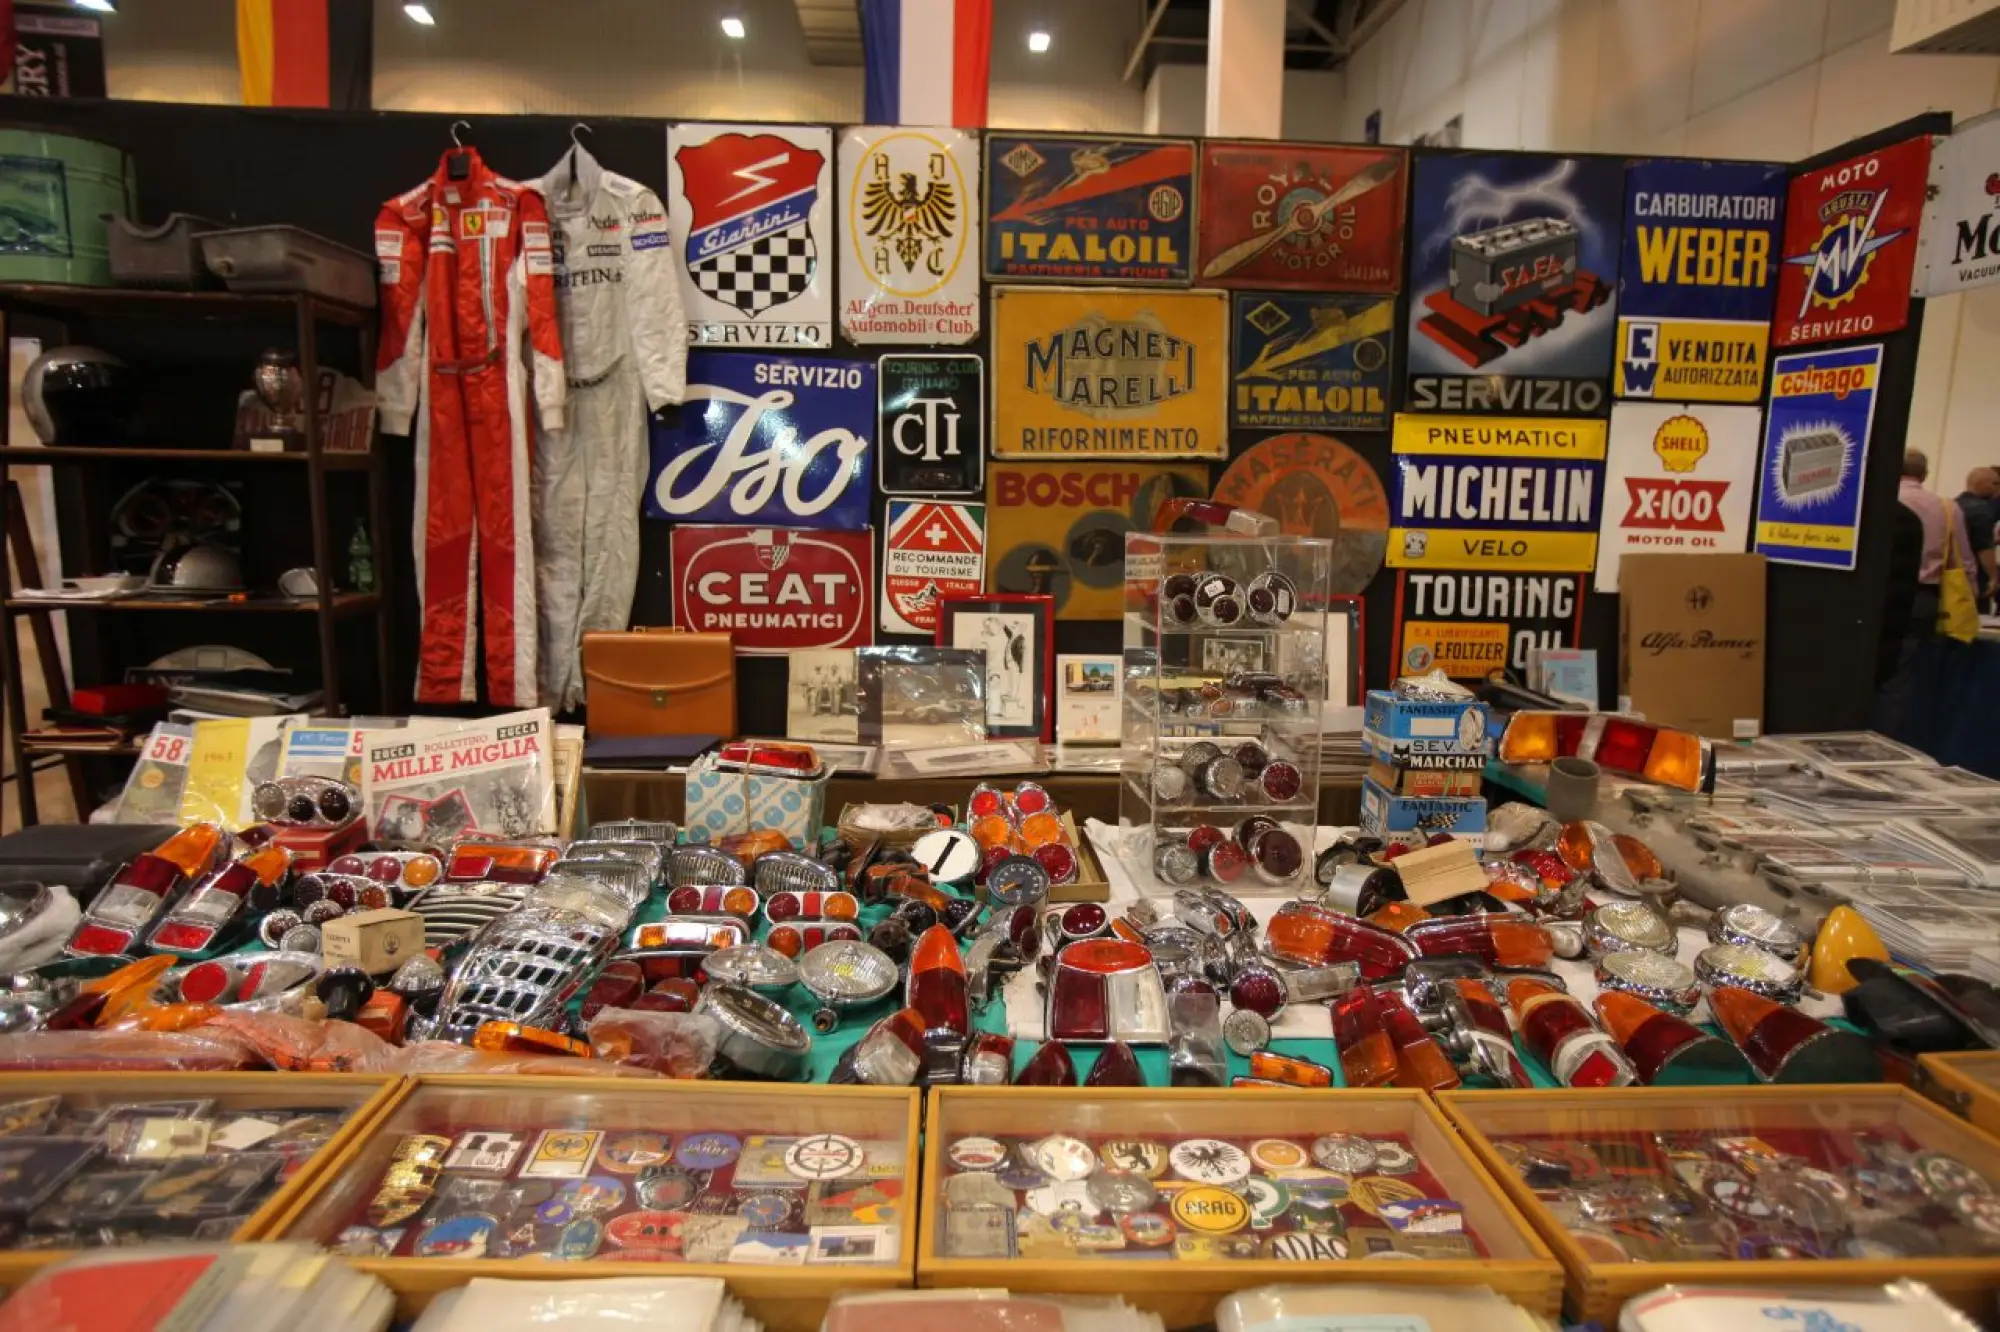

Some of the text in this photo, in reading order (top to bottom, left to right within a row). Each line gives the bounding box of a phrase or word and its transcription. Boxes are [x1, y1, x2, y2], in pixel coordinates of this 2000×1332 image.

[1820, 158, 1879, 192] MOTO
[1635, 192, 1776, 221] CARBURATORI
[698, 203, 801, 255] Giannini
[1272, 205, 1356, 269] MOTOR OIL
[1001, 232, 1178, 265] ITALOIL
[1636, 225, 1771, 289] WEBER
[689, 324, 820, 343] SERVIZIO
[1790, 315, 1874, 341] SERVIZIO
[1669, 339, 1757, 364] VENDITA
[755, 363, 862, 389] SERVIZIO
[1663, 366, 1759, 387] AUTORIZZATA
[1780, 366, 1865, 400] colnago
[1236, 385, 1385, 413] ITALOIL
[1414, 378, 1602, 412] SERVIZIO
[1022, 428, 1199, 450] RIFORNIMENTO
[1429, 428, 1577, 448] PNEUMATICI
[1661, 436, 1702, 453] SHELL
[996, 472, 1140, 507] BOSCH
[1402, 465, 1593, 523] MICHELIN
[1635, 488, 1713, 522] X-100
[1463, 538, 1528, 557] VELO
[1627, 534, 1717, 547] MOTOR OIL
[916, 565, 973, 577] TOURISME
[697, 573, 847, 606] CEAT
[1409, 575, 1575, 618] TOURING
[704, 612, 843, 629] PNEUMATICI
[1641, 631, 1687, 656] Alfa
[151, 735, 184, 761] 58
[424, 733, 488, 753] BOLLETTINO
[1413, 740, 1456, 751] S.E.V.
[372, 736, 539, 783] MILLE MIGLIA
[1410, 755, 1485, 768] MARCHAL
